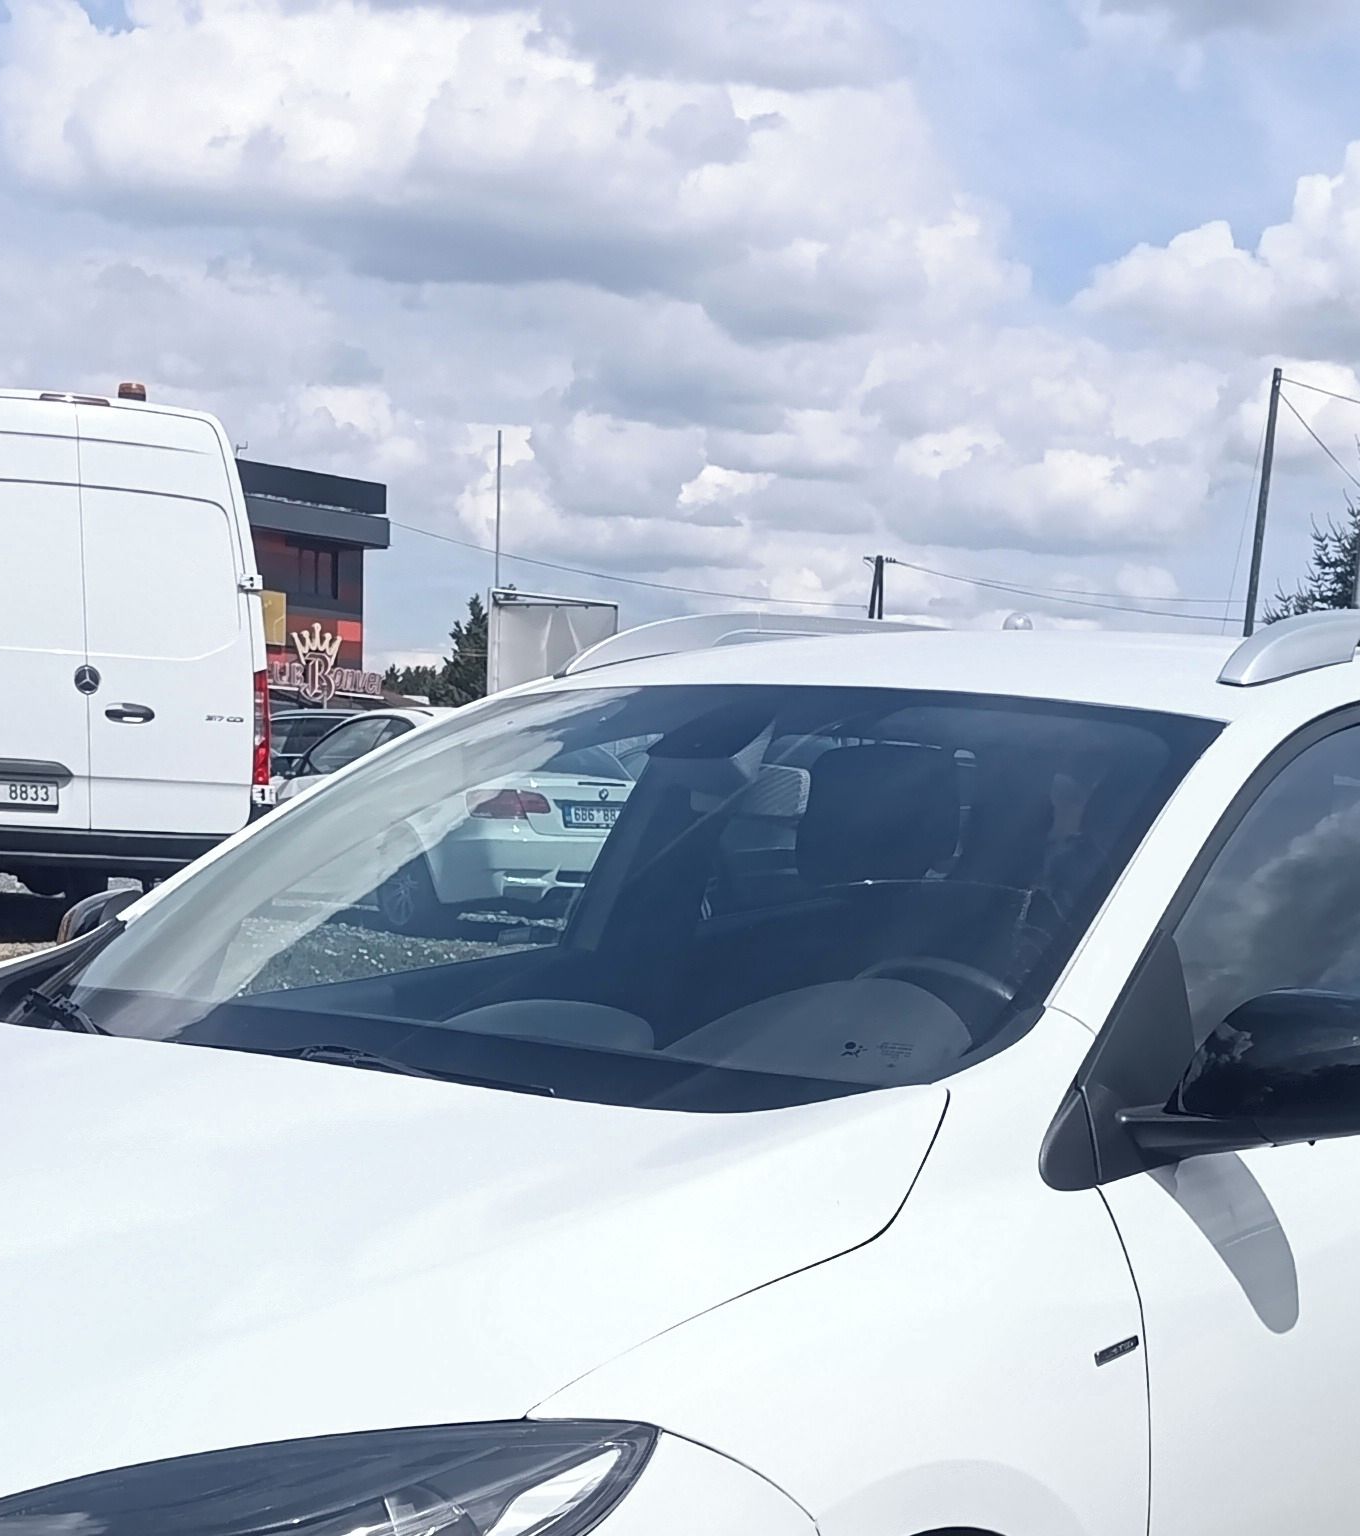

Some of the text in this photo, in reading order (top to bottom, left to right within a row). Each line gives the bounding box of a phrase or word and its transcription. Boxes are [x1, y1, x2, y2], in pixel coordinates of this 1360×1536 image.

[267, 660, 305, 687] UB
[9, 783, 49, 801] 8833
[603, 807, 621, 821] 88
